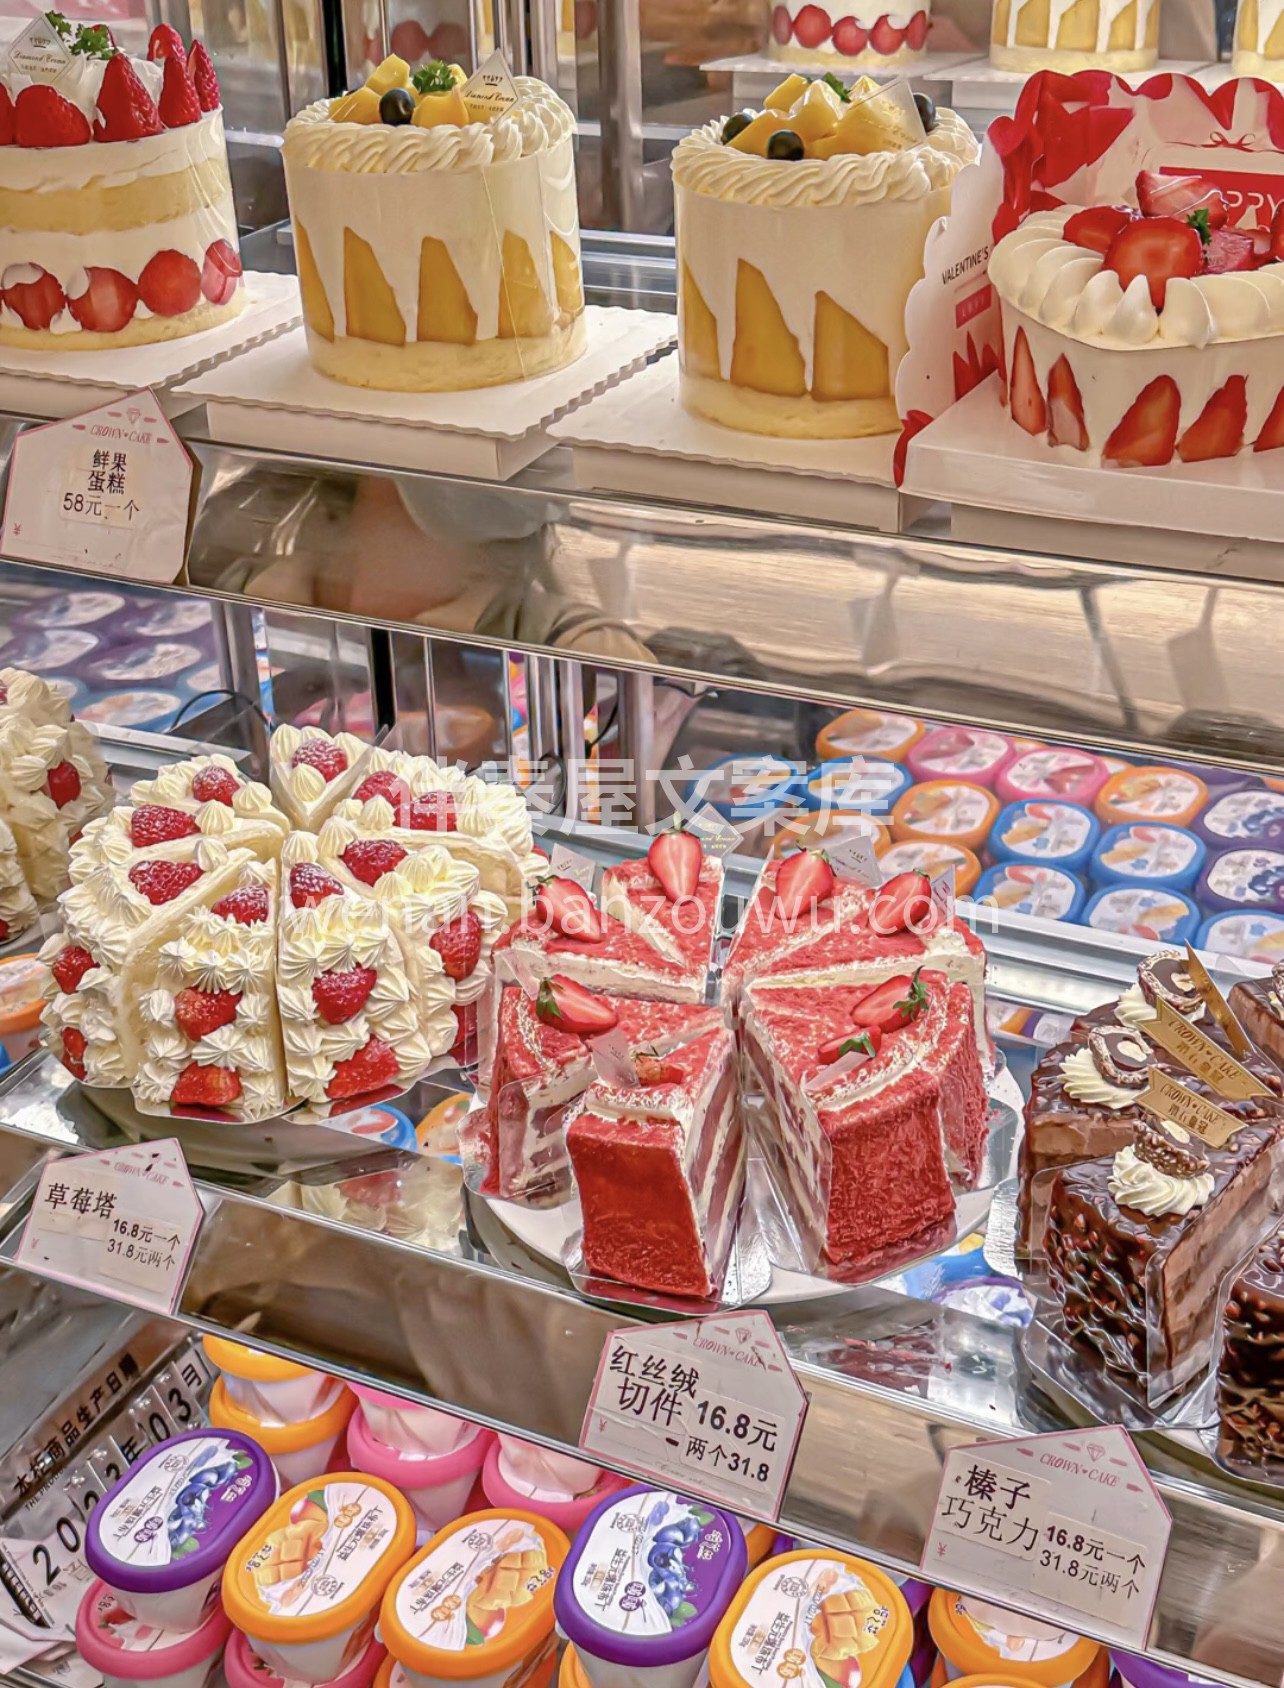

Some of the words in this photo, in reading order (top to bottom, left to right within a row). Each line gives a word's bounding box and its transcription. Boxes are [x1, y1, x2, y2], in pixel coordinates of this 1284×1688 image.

[942, 246, 989, 285] VALENTINE'S
[90, 424, 124, 440] CROWN
[129, 431, 152, 444] CAKE
[92, 449, 127, 473] 鲜果
[88, 470, 126, 495] 蛋糕
[63, 492, 140, 521] 58元一个
[1168, 1020, 1209, 1056] CROWN
[1211, 1053, 1240, 1080] CAKE
[44, 1183, 118, 1220] 草莓塔
[114, 1218, 180, 1251] 16.8元一个
[107, 1239, 176, 1272] 31.8元两个
[610, 1346, 700, 1398] 红丝绒
[618, 1377, 684, 1427] 切件
[697, 1400, 778, 1452] 16.8元
[964, 1464, 1030, 1510] 榛子
[1040, 1452, 1082, 1475] CROWN
[1088, 1468, 1120, 1488] CAKE
[941, 1496, 1039, 1552] 巧克力
[1046, 1525, 1146, 1575] 16.8元一个
[1040, 1550, 1140, 1600] 31.8元两个
